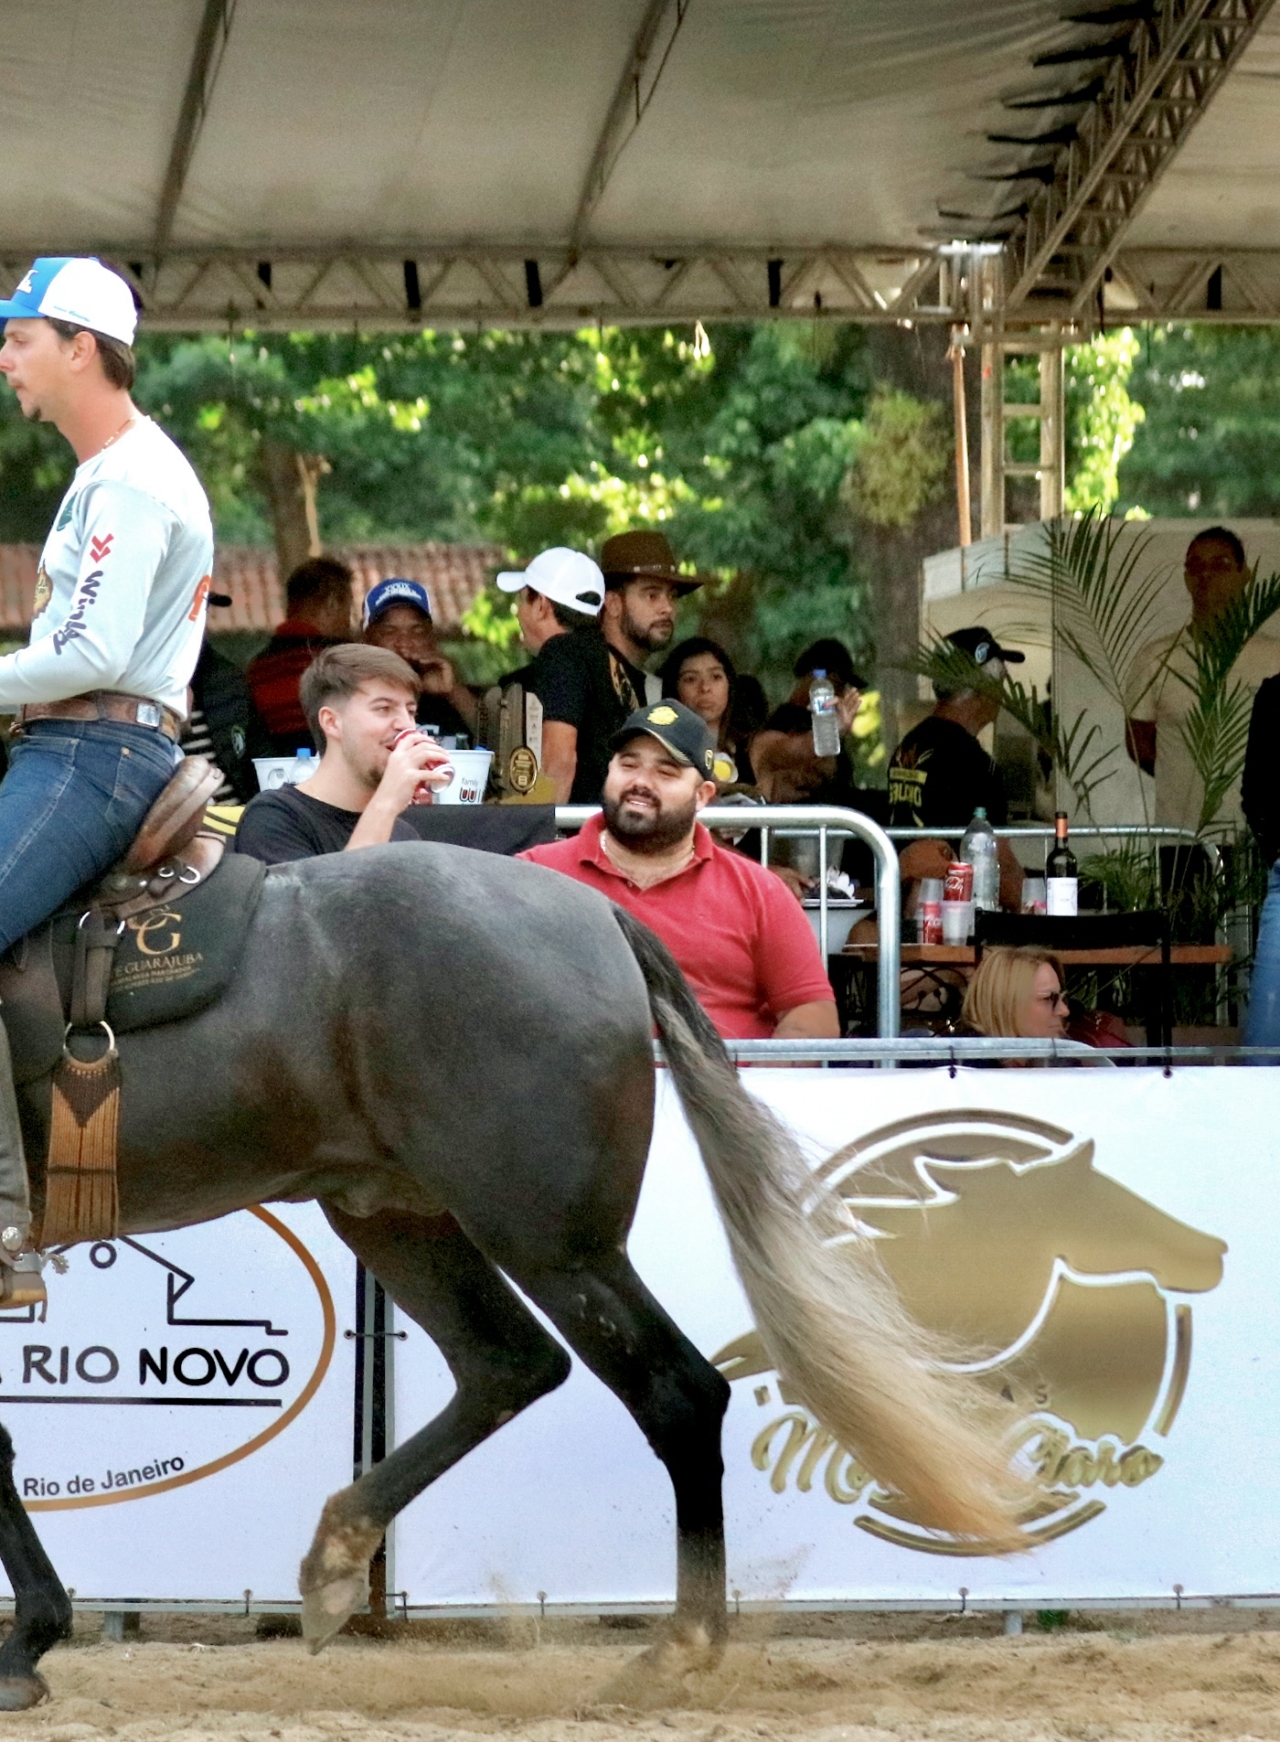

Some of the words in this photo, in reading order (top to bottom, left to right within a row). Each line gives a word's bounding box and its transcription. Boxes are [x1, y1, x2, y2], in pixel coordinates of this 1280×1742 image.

[124, 952, 204, 974] GUARAJUBA
[22, 1344, 120, 1385] RIO
[138, 1345, 290, 1388] NOVO
[22, 1477, 60, 1497] Rio
[66, 1475, 95, 1495] de
[100, 1456, 185, 1490] Janeiro
